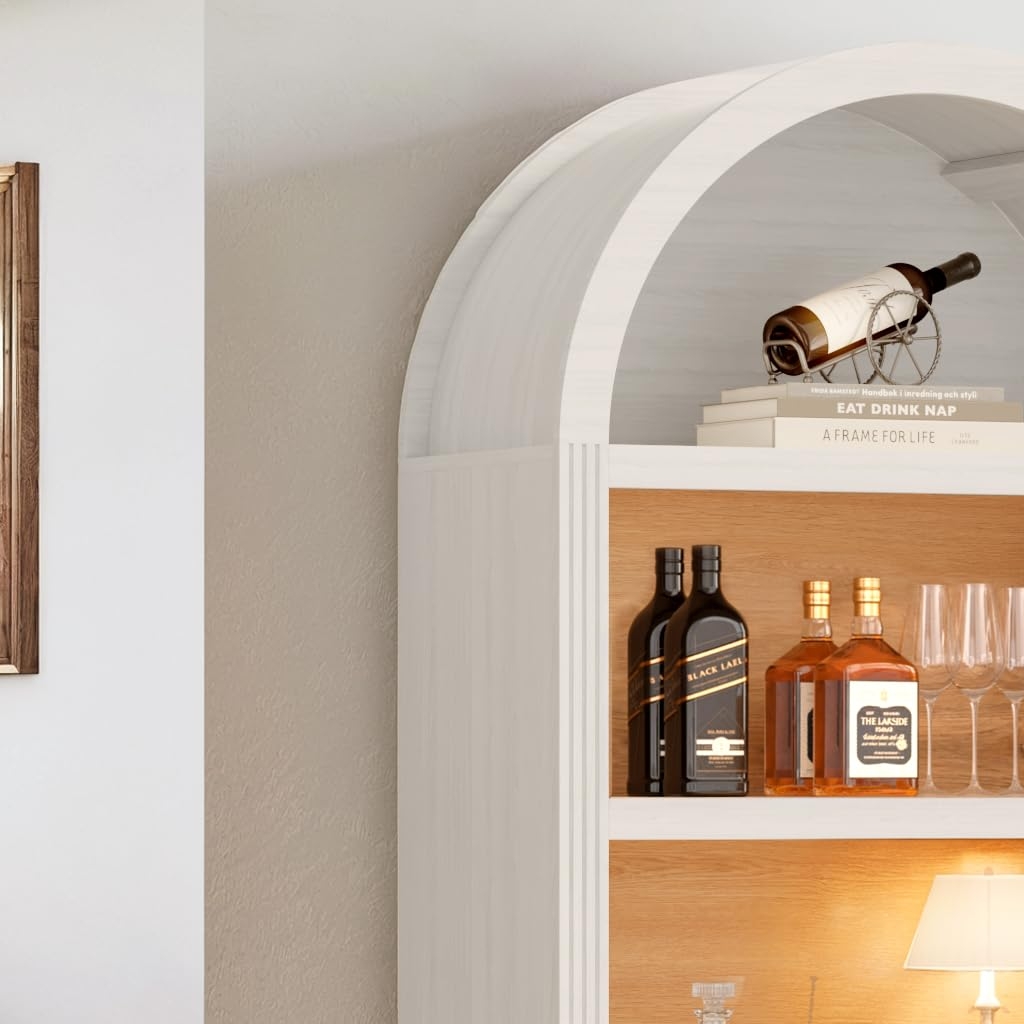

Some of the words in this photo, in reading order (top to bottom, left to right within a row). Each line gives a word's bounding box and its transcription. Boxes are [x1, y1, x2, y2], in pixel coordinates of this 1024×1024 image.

[862, 388, 898, 397] Handbok
[904, 389, 943, 399] inredning
[944, 390, 959, 398] och
[836, 402, 866, 414] EAT
[871, 403, 920, 416] DRINK
[924, 404, 957, 416] NAP
[823, 429, 831, 441] A
[834, 429, 879, 443] FRAME
[882, 430, 907, 443] FOR
[910, 431, 936, 444] LIFE
[687, 665, 719, 682] BLACK
[861, 716, 877, 726] THE
